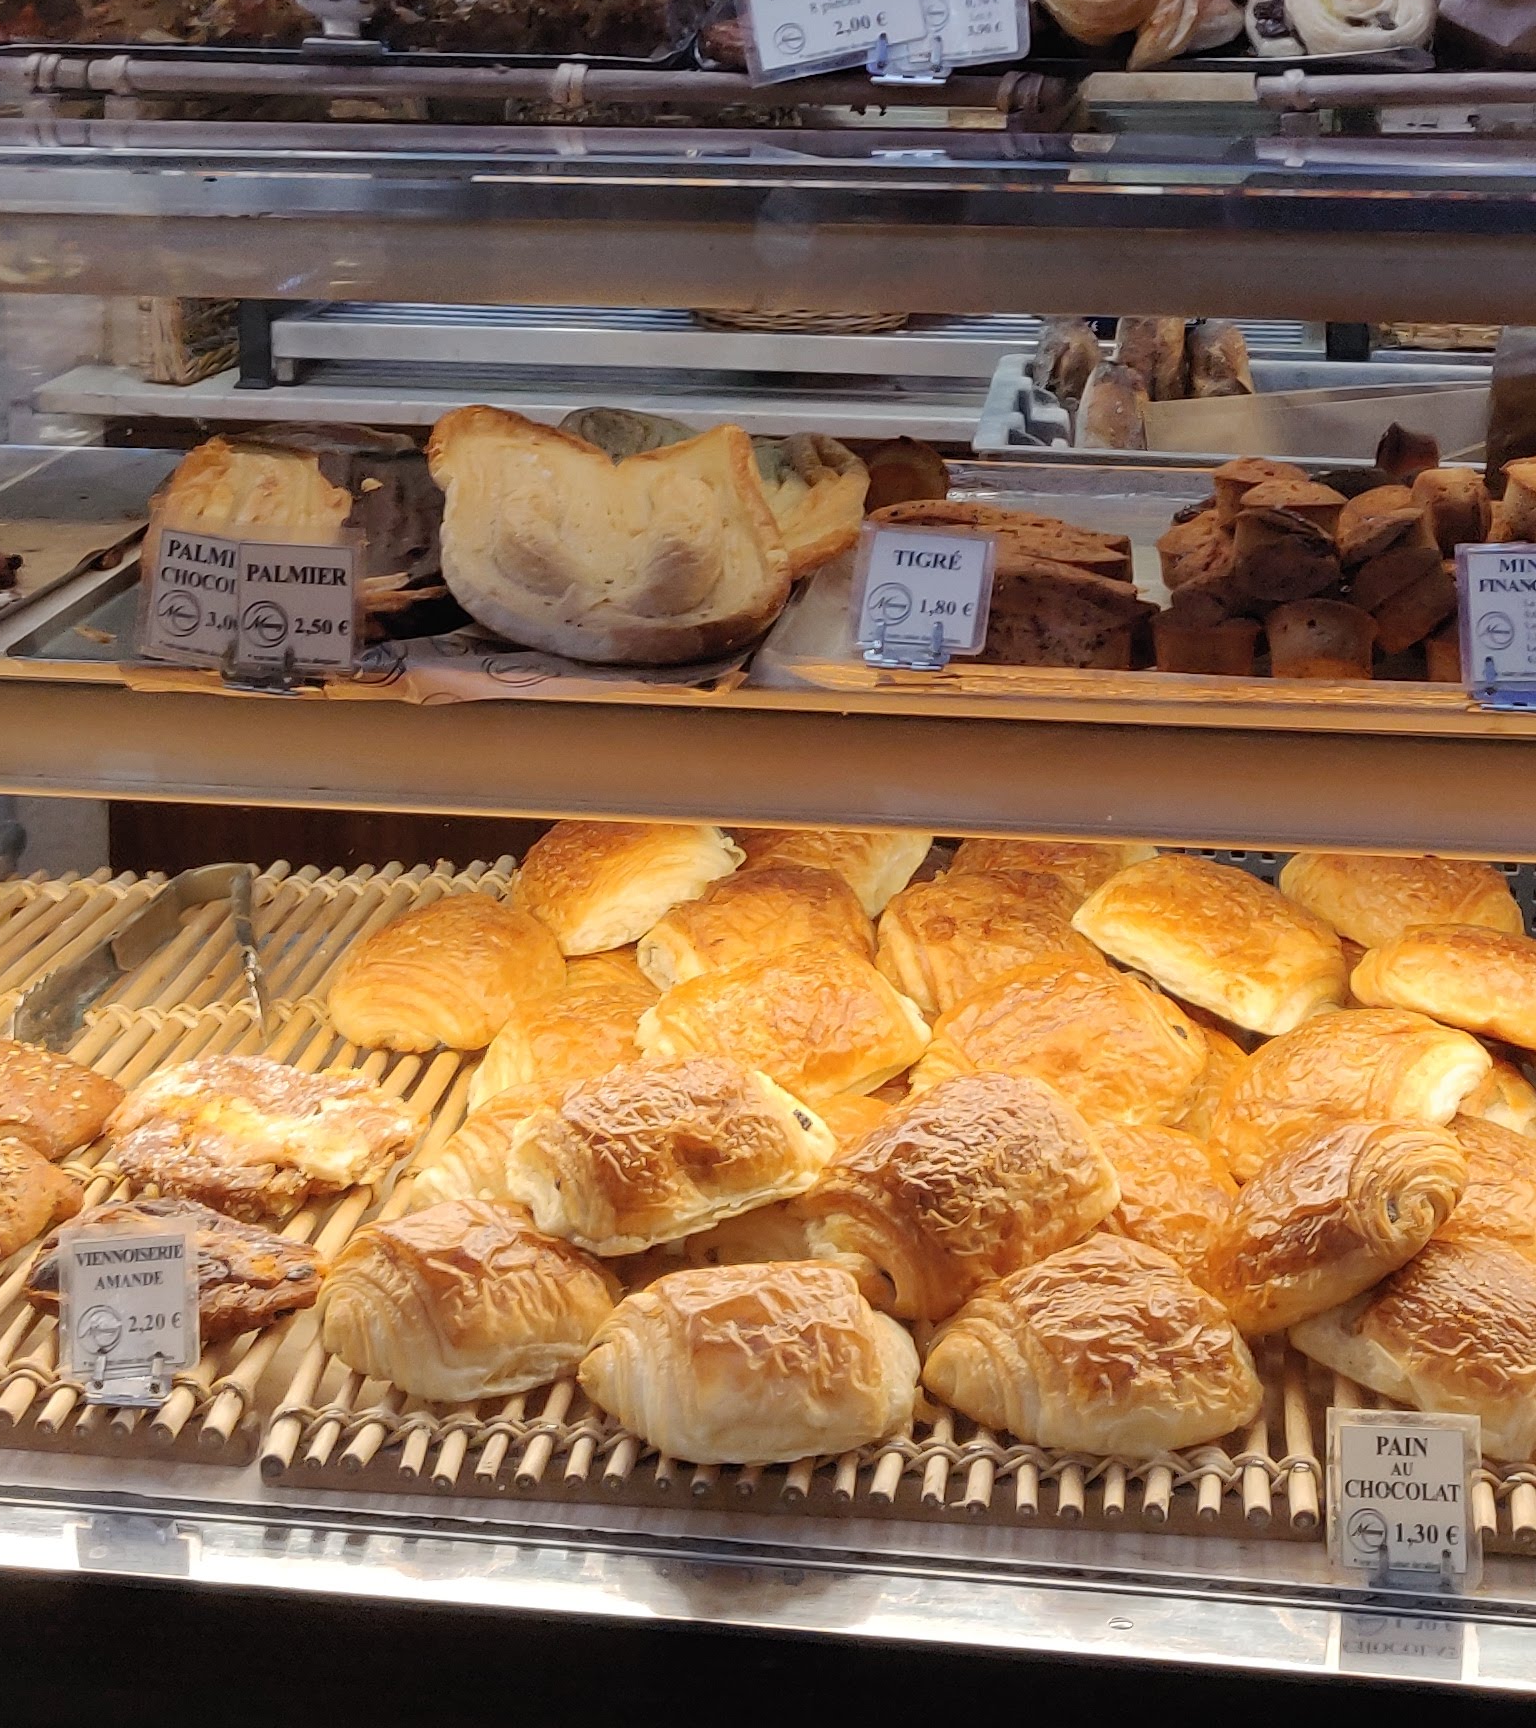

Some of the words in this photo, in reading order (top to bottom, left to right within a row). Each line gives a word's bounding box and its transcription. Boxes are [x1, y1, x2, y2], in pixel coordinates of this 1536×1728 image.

[833, 14, 872, 37] 2,00
[167, 539, 237, 570] PALMI
[893, 549, 963, 571] TIGRÉ
[161, 566, 236, 596] CHOCO
[247, 563, 348, 586] PALMIER
[919, 599, 957, 617] 1,80
[294, 617, 333, 637] 2,50
[338, 619, 349, 636] €
[75, 1244, 184, 1268] VIENNOISERIE
[94, 1270, 164, 1291] AMANDE
[128, 1314, 165, 1334] 2,20
[171, 1311, 182, 1330] €
[1376, 1435, 1428, 1457] PAIN
[1390, 1462, 1414, 1477] AU
[1344, 1479, 1462, 1503] CHOCOLAT
[1395, 1522, 1438, 1547] 1,30
[1445, 1524, 1460, 1546] €
